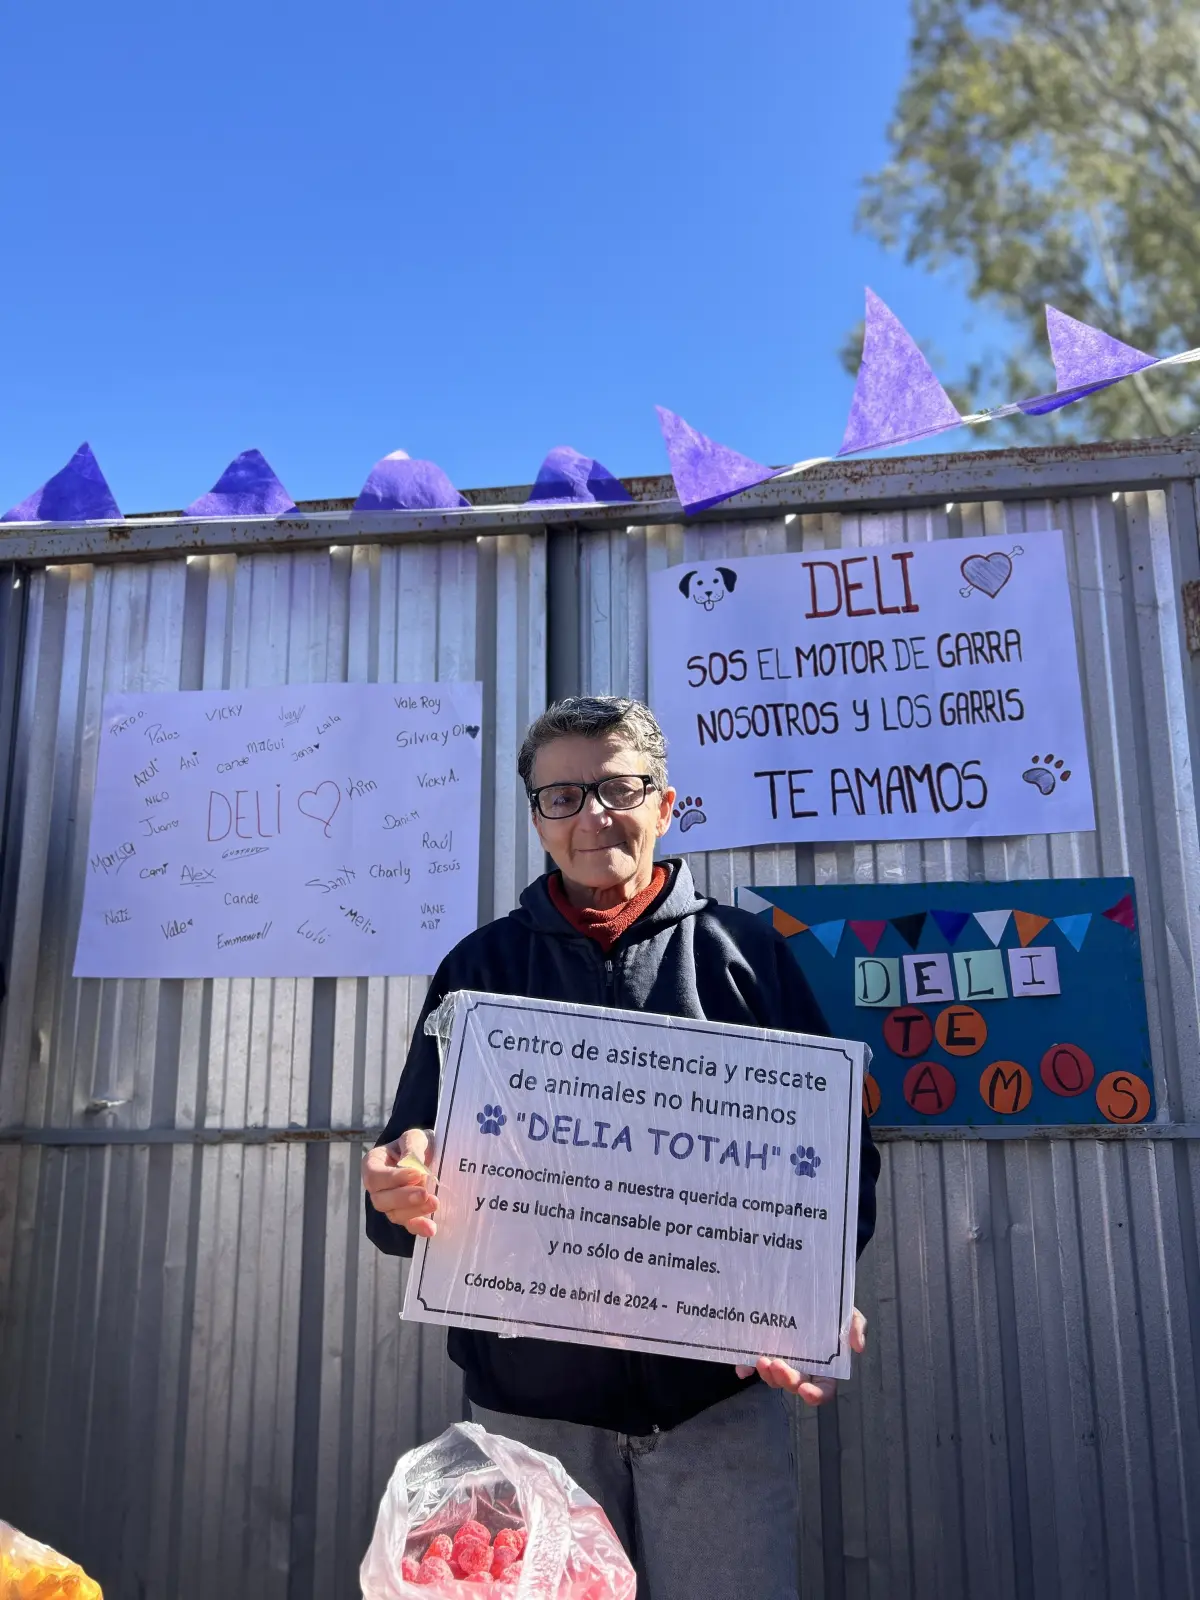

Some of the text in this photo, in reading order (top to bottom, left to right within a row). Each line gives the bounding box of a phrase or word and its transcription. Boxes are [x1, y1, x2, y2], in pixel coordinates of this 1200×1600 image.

[801, 551, 920, 620] DELI
[686, 628, 1023, 688] SOS EL MOTOR DE GARRA
[205, 704, 243, 722] VICKY
[316, 715, 342, 735] Laila
[393, 695, 441, 715] Vale Roy
[696, 701, 840, 747] NOSOTROS
[880, 694, 932, 731] LOS
[939, 688, 1025, 727] GARRIS
[753, 759, 988, 820] TE AMAMOS
[422, 830, 453, 852] Raúl
[224, 892, 260, 906] Cande
[369, 860, 412, 885] Charly
[420, 902, 446, 916] VANE
[857, 954, 1046, 1004] DELI
[487, 1028, 827, 1092] Centro de asistencia y rescate
[892, 1011, 977, 1053] TE
[509, 1068, 797, 1125] de animales no humanos
[862, 1049, 1138, 1120] AMOS
[516, 1111, 781, 1171] "DELIA TOTAH"
[458, 1158, 828, 1221] En reconocimiento a nuestra querida compañera
[474, 1195, 803, 1251] y de su lucha incansable por cambiar vidas
[547, 1239, 721, 1275] y no sólo de animales.
[464, 1272, 526, 1295] Córdoba,
[529, 1281, 546, 1296] 29
[549, 1284, 567, 1299] de
[569, 1287, 600, 1303] abril
[603, 1290, 622, 1306] de
[623, 1293, 658, 1311] 2024
[676, 1300, 745, 1323] Fundación
[749, 1310, 798, 1330] GARRA
